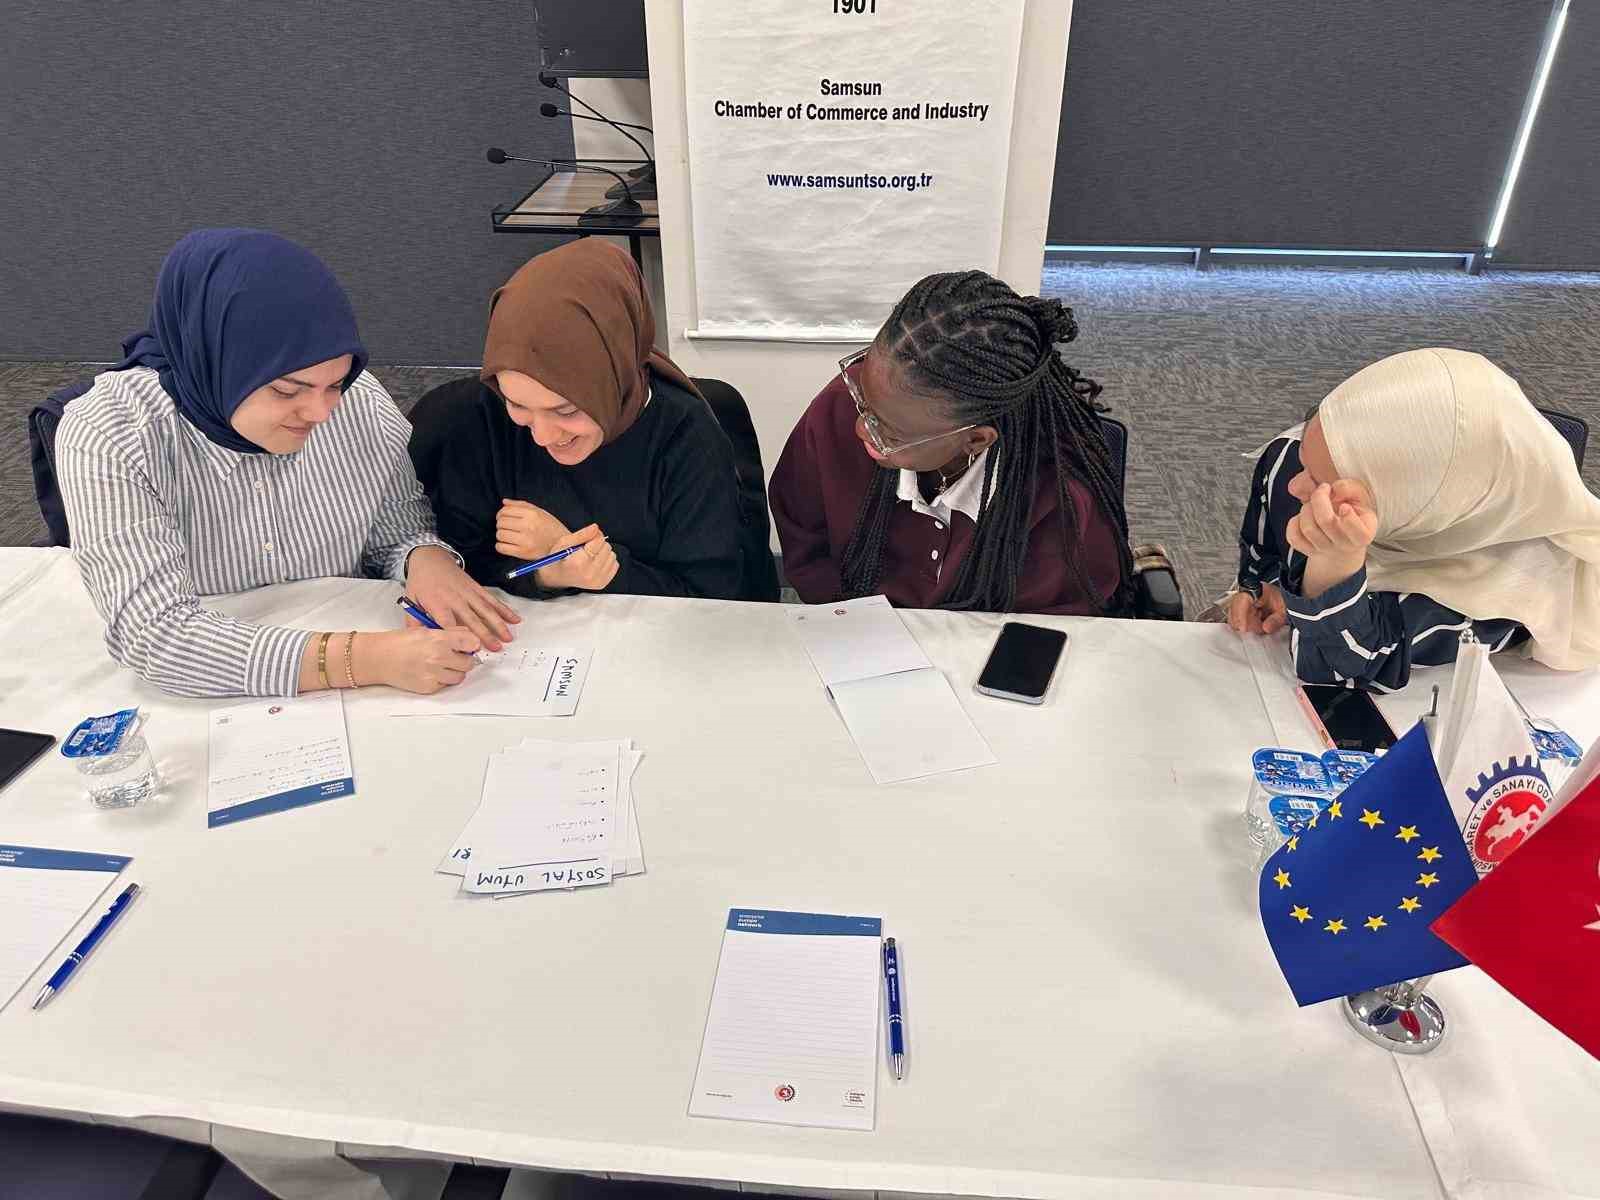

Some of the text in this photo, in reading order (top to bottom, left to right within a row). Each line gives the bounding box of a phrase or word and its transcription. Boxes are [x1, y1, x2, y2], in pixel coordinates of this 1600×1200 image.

[833, 0, 876, 14] 1901
[820, 78, 882, 96] Samsun
[714, 100, 990, 122] Chamber of Commerce and Industry
[766, 172, 933, 192] www.samsuntso.org.tr
[555, 658, 579, 697] SAMSUN
[1480, 798, 1493, 812] ve
[475, 865, 607, 889] SOSYAL UYUM
